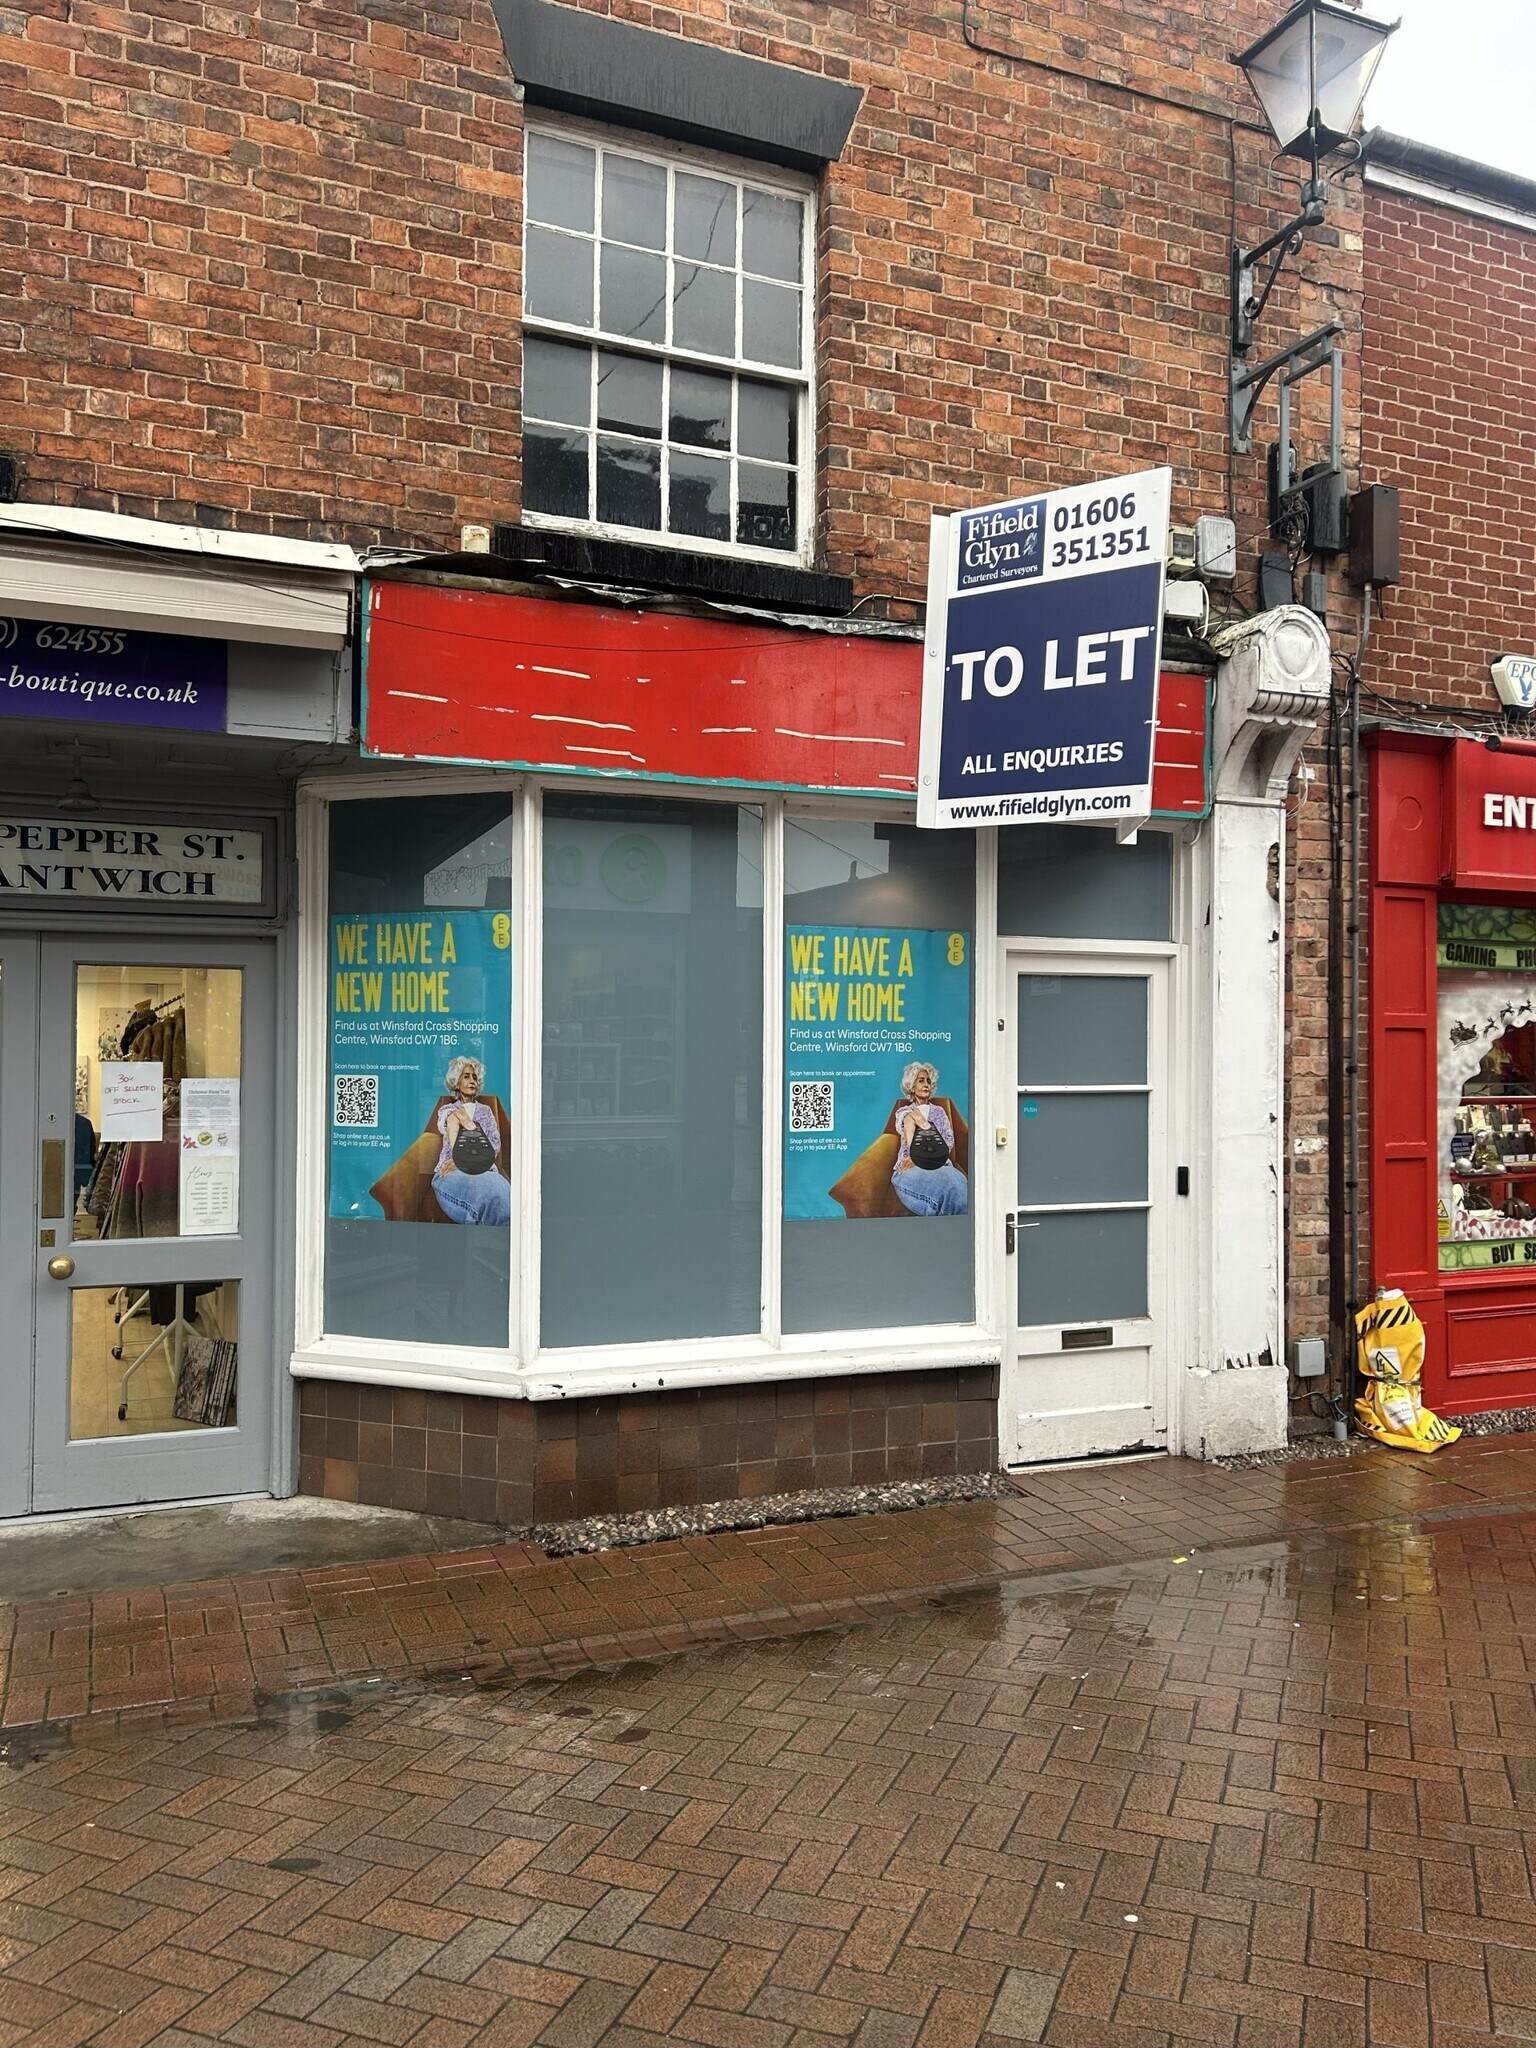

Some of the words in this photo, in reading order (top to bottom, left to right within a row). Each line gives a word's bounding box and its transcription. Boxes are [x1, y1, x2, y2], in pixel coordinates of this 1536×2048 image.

[966, 506, 1039, 543] Fifield
[1054, 493, 1136, 532] 01606
[965, 539, 1021, 568] Glyn
[1052, 526, 1150, 567] 351351
[962, 570, 998, 584] Chartered
[1000, 564, 1038, 579] Surveyors
[36, 625, 127, 655] 624555
[951, 645, 1024, 701] TO
[1044, 625, 1150, 691] LET
[961, 754, 997, 775] ALL
[1002, 741, 1123, 773] ENQUIRIES
[950, 794, 1131, 820] www.fifieldglyn.com
[0, 824, 163, 856] PEPPER
[182, 834, 246, 860] ST.
[336, 923, 368, 965] WE
[376, 923, 432, 964] HAVE
[441, 922, 457, 964] A
[790, 935, 825, 975] WE
[834, 937, 891, 976] HAVE
[898, 938, 914, 977] A
[1446, 942, 1497, 967] GAMING
[336, 972, 383, 1013] NEW
[391, 971, 449, 1013] HOME
[790, 982, 840, 1021] NEW
[847, 982, 905, 1022] HOME
[335, 1020, 355, 1030] Find
[357, 1022, 367, 1030] us
[369, 1022, 379, 1030] at
[381, 1020, 424, 1031] Winsford
[425, 1021, 452, 1031] Cross
[453, 1021, 499, 1034] Shopping
[335, 1034, 368, 1045] Centre,
[370, 1034, 413, 1045] Winsford
[415, 1035, 437, 1045] CW7
[440, 1035, 460, 1045] 1BG.
[790, 1028, 810, 1038] Find
[812, 1031, 822, 1039] us
[824, 1030, 835, 1039] at
[837, 1029, 879, 1039] Winsford
[880, 1029, 906, 1039] Cross
[908, 1030, 951, 1042] Shopping
[790, 1042, 823, 1053] Centre,
[825, 1042, 868, 1052] Winsford
[870, 1042, 892, 1052] CW7
[894, 1042, 915, 1052] 1BG.
[105, 1086, 119, 1094] OFF
[1491, 1243, 1515, 1264] BUY
